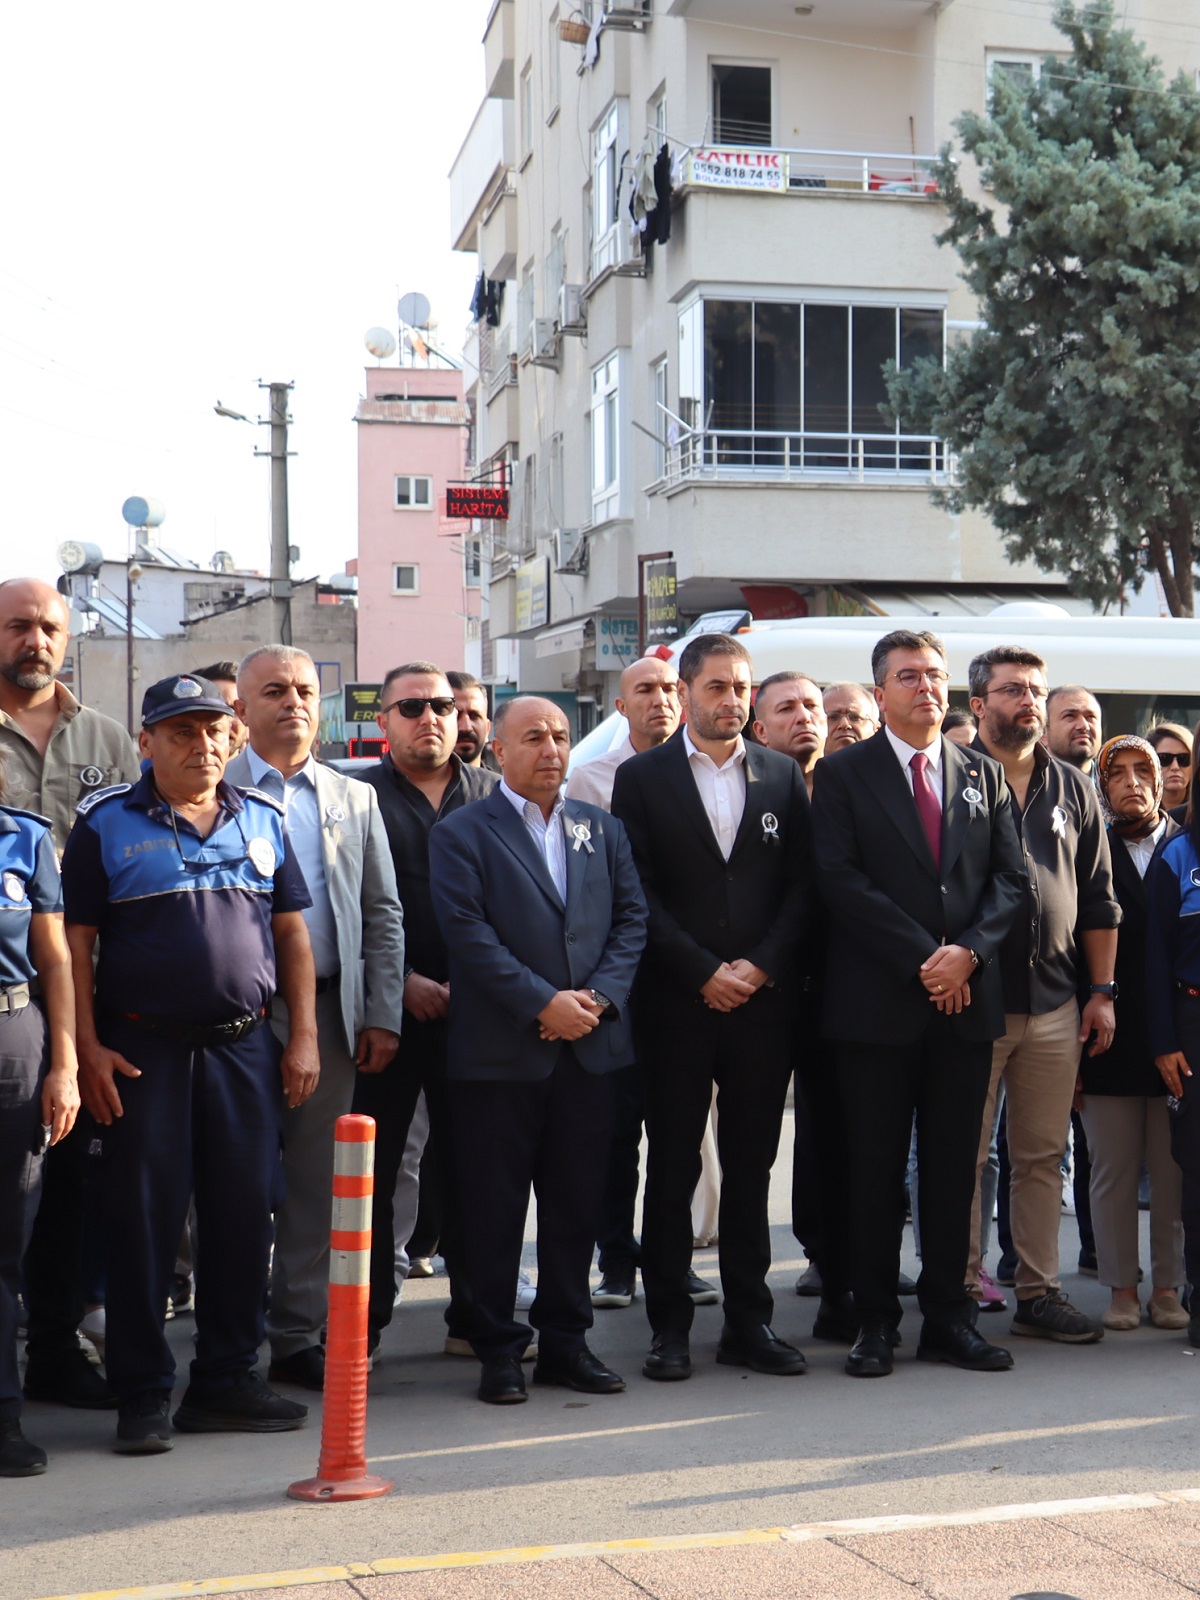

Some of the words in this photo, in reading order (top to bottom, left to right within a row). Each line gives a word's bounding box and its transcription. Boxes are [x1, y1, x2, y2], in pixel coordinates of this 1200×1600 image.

[693, 162, 721, 176] 0552
[724, 166, 746, 179] 818
[749, 169, 763, 180] 74
[766, 171, 781, 181] 55
[450, 501, 507, 516] HARİTA
[601, 619, 640, 635] SSTE
[123, 838, 177, 859] ZABITA
